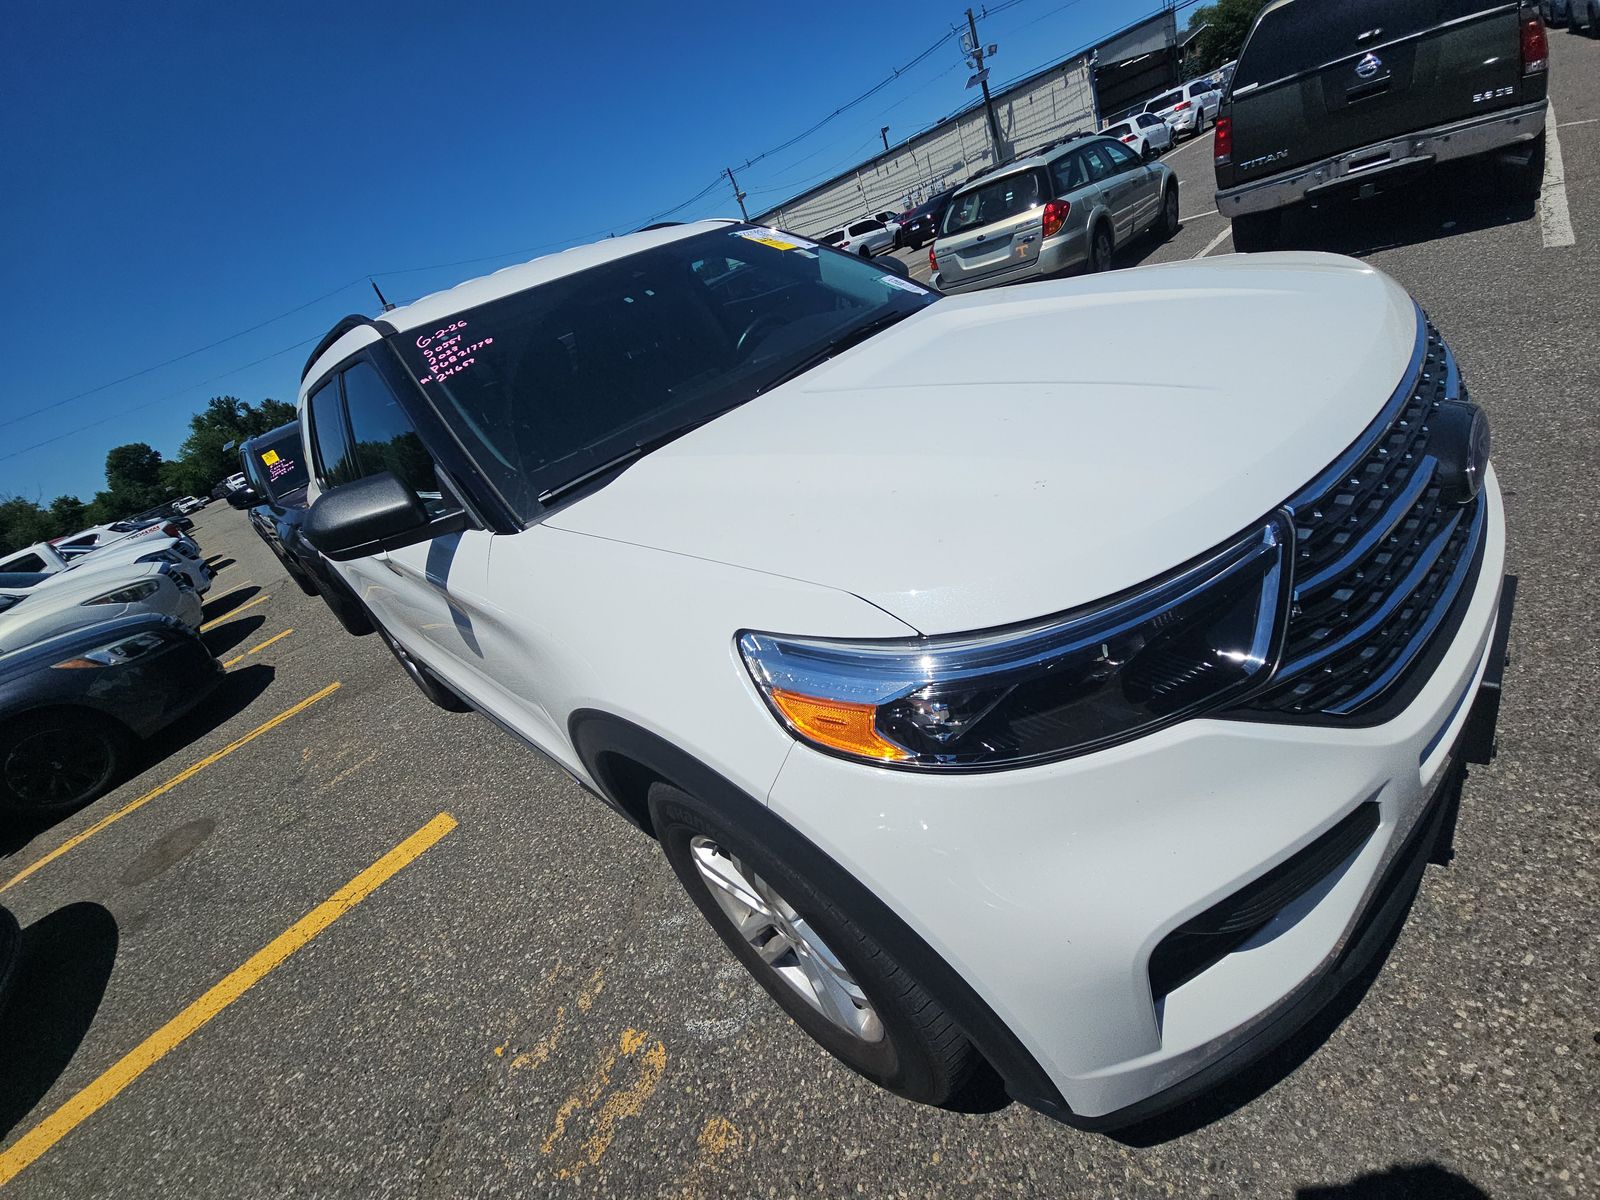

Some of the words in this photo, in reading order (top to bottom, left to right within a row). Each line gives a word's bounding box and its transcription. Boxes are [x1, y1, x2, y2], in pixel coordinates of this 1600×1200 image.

[1495, 86, 1513, 97] SE
[1240, 149, 1288, 169] TITAN
[1016, 244, 1029, 258] T
